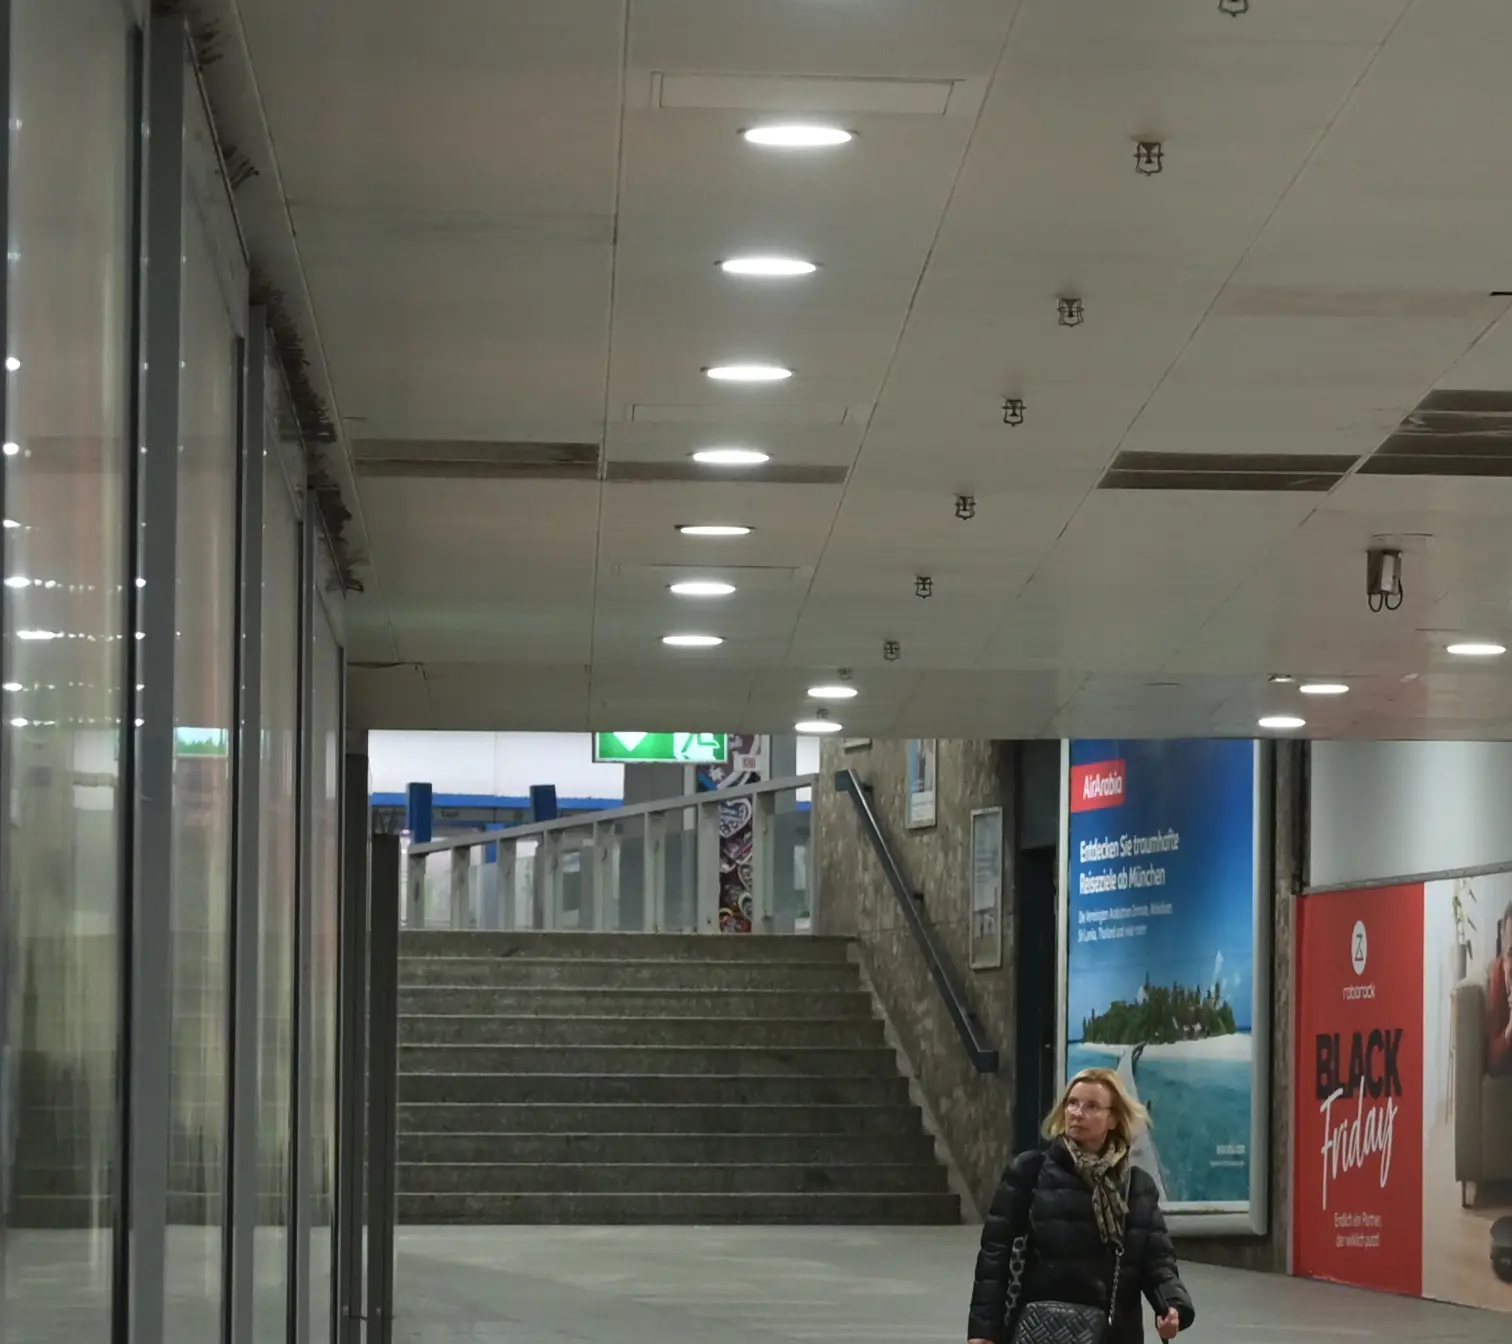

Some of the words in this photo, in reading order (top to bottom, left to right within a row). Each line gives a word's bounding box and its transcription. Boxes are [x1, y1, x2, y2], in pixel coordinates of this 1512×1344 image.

[1080, 835, 1120, 864] Entdecken
[1119, 832, 1133, 858] Sie
[1128, 862, 1166, 889] München
[1315, 1027, 1404, 1101] BLACK
[1319, 1074, 1399, 1211] Friday
